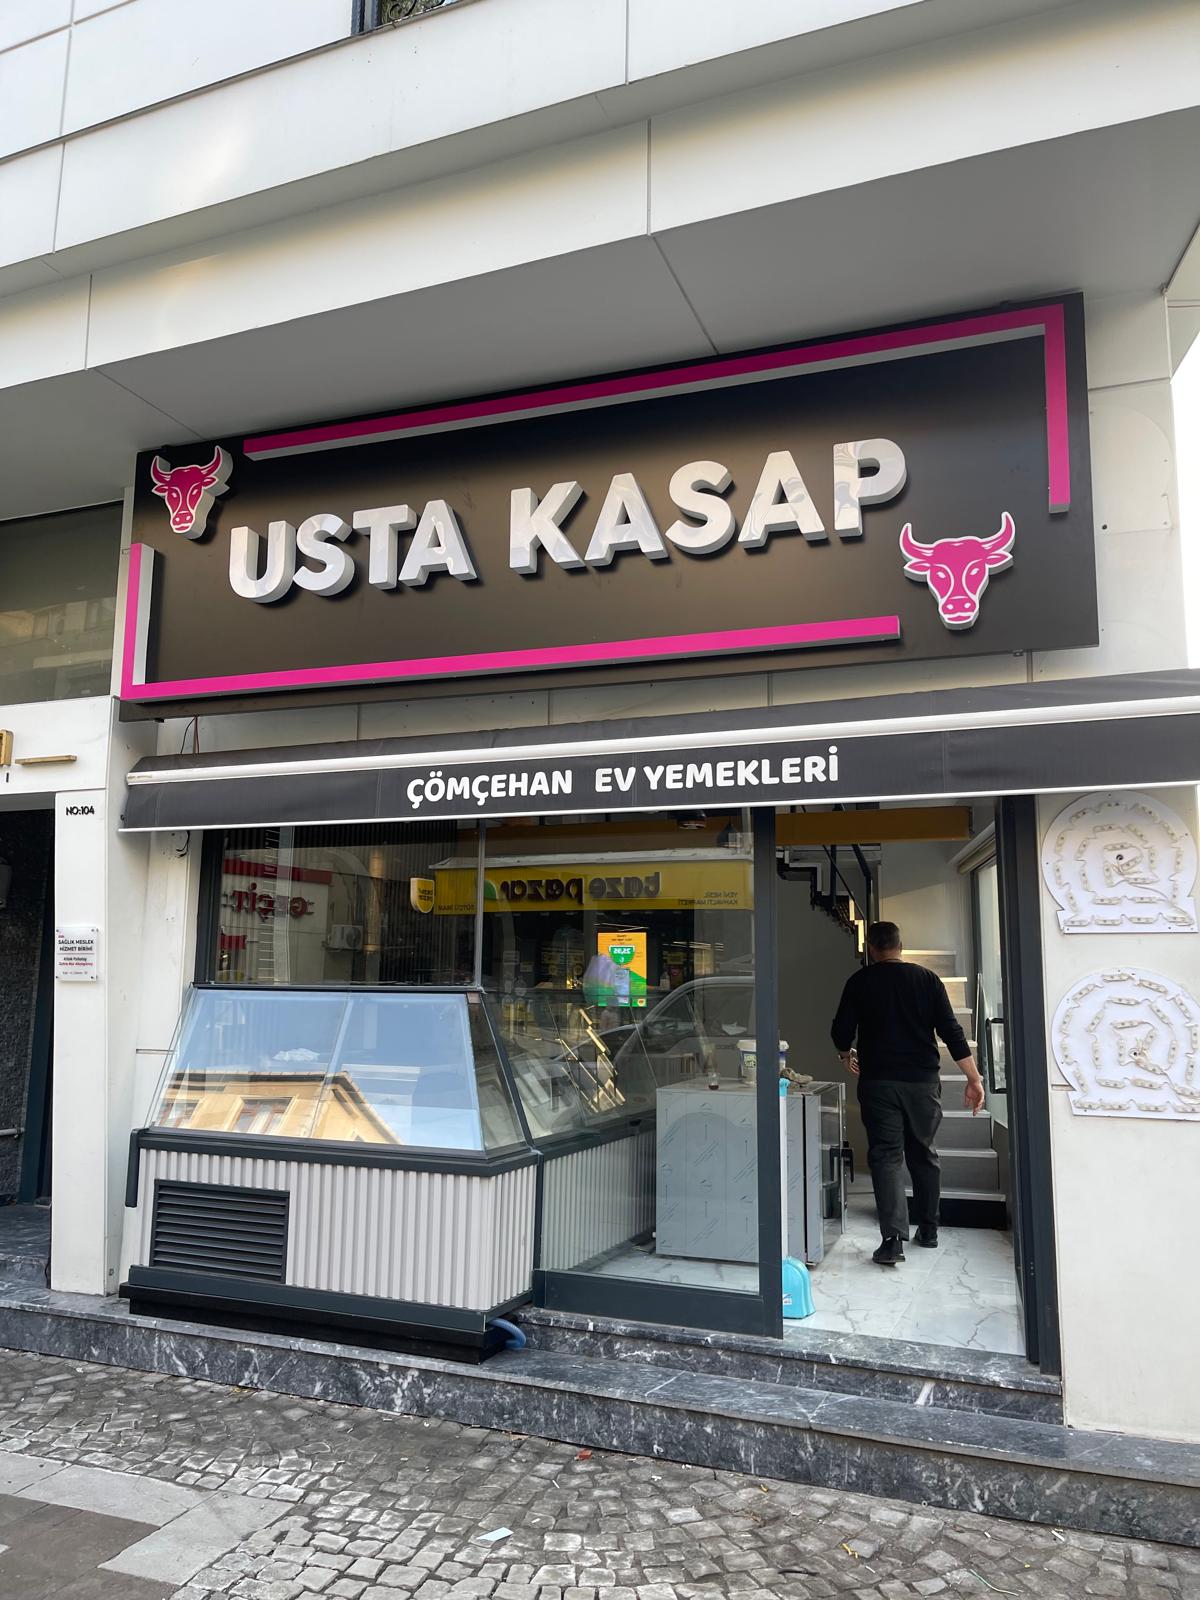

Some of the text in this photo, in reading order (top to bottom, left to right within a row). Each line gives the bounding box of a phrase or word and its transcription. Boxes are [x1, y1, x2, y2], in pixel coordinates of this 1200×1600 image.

[228, 437, 908, 603] USTA KASAP
[406, 745, 839, 808] ÇÖMÇEHAN EV YEMEKLERİ
[65, 805, 95, 816] NO:104
